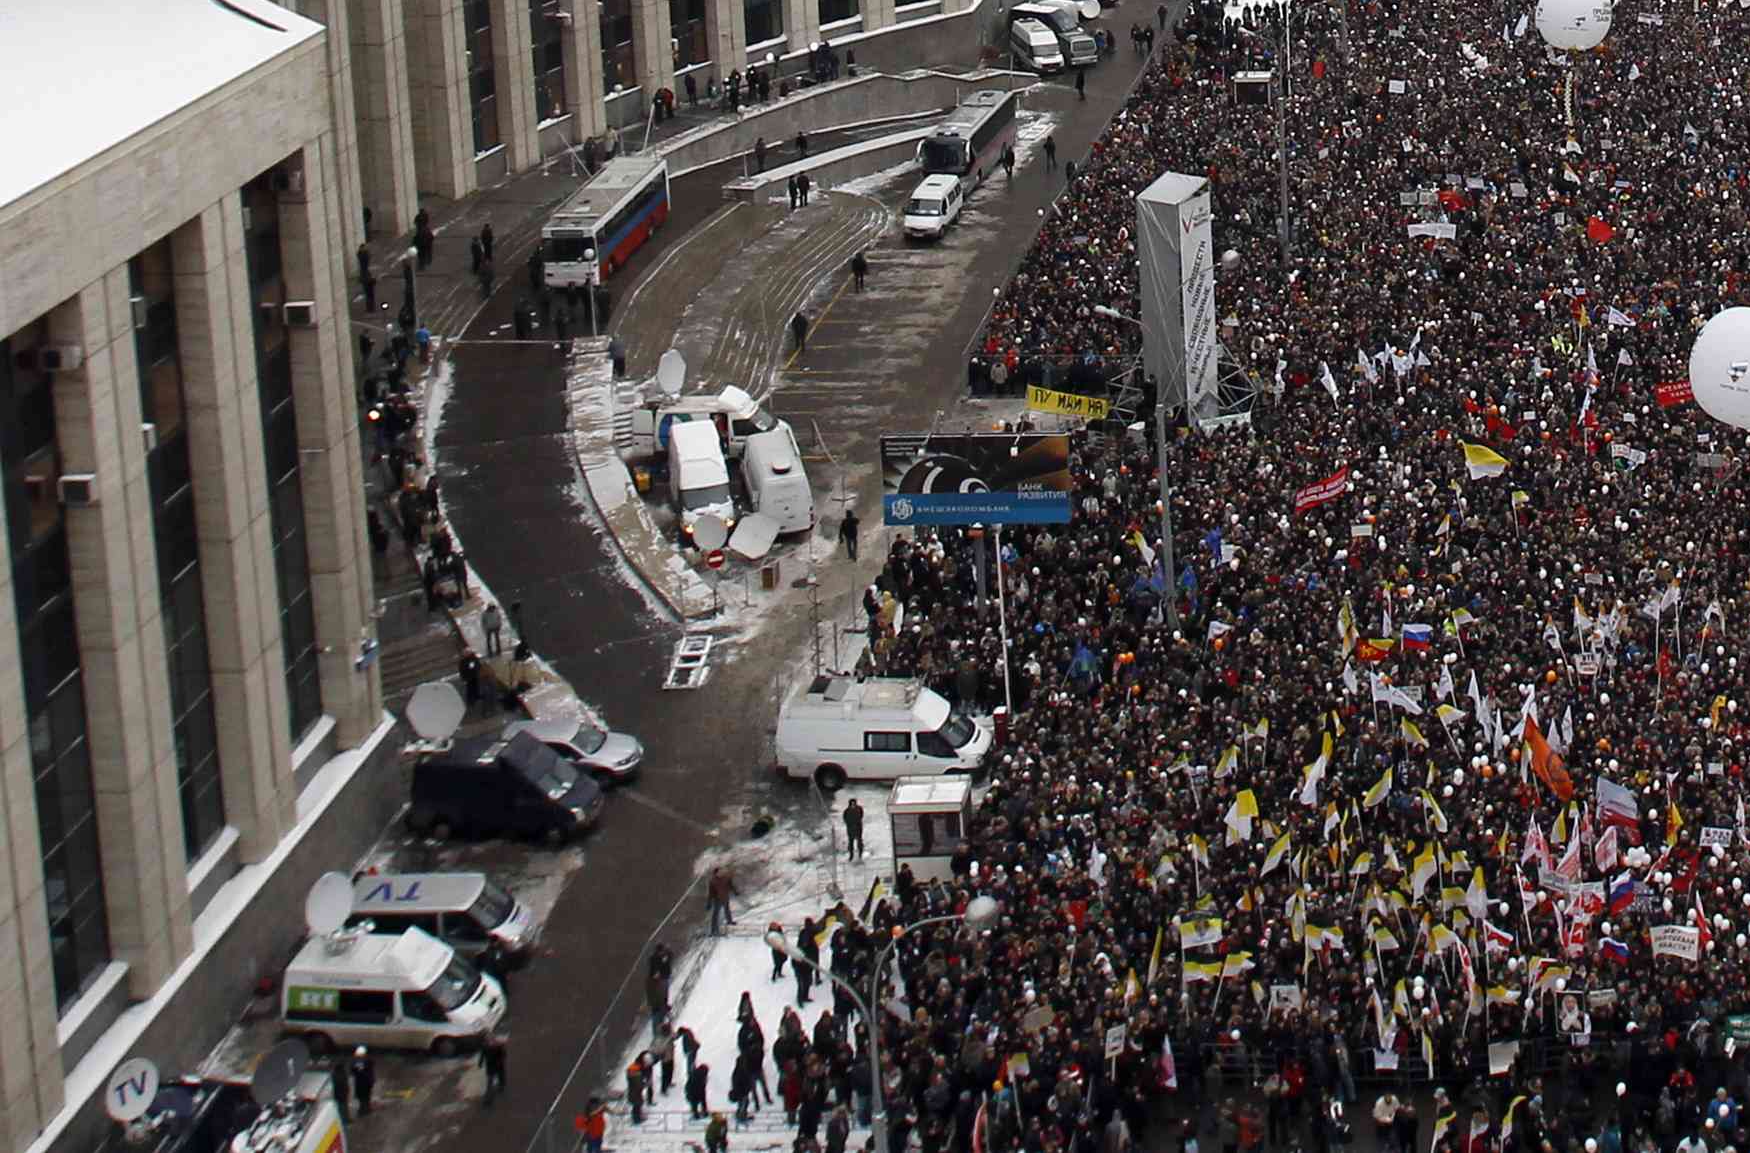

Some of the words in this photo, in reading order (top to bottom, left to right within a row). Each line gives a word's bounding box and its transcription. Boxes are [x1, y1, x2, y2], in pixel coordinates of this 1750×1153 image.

[1033, 389, 1051, 403] ПУ
[1088, 400, 1104, 414] НА
[1017, 490, 1067, 500] РАЗВИТИЯ
[362, 881, 422, 902] TV
[299, 991, 337, 1007] RT
[114, 1070, 147, 1106] TV
